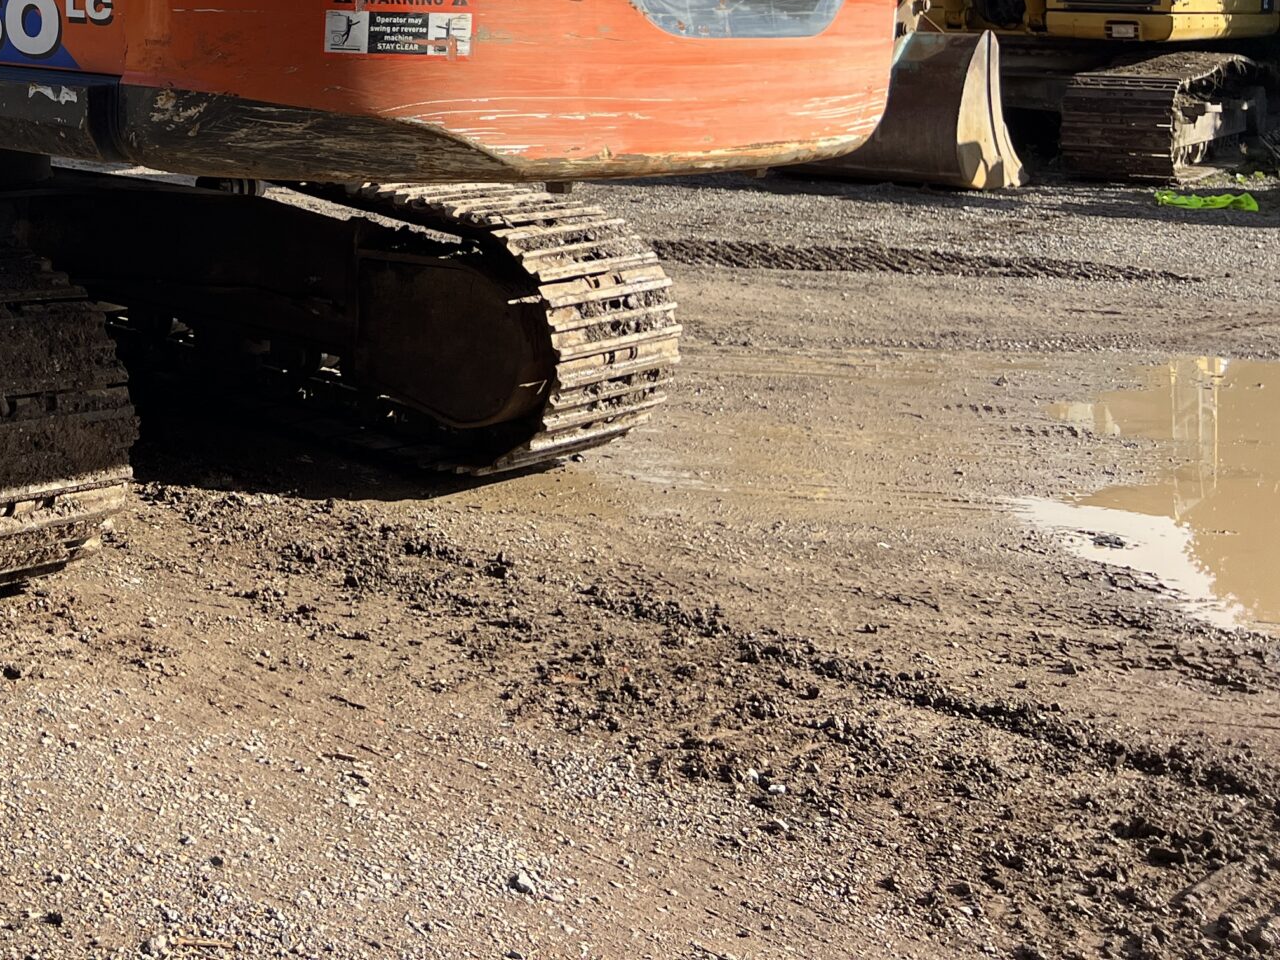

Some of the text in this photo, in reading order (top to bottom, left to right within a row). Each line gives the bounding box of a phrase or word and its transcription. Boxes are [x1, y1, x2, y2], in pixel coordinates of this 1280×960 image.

[376, 16, 422, 25] Operator may
[370, 26, 390, 34] swing
[396, 43, 419, 51] CLEAR
